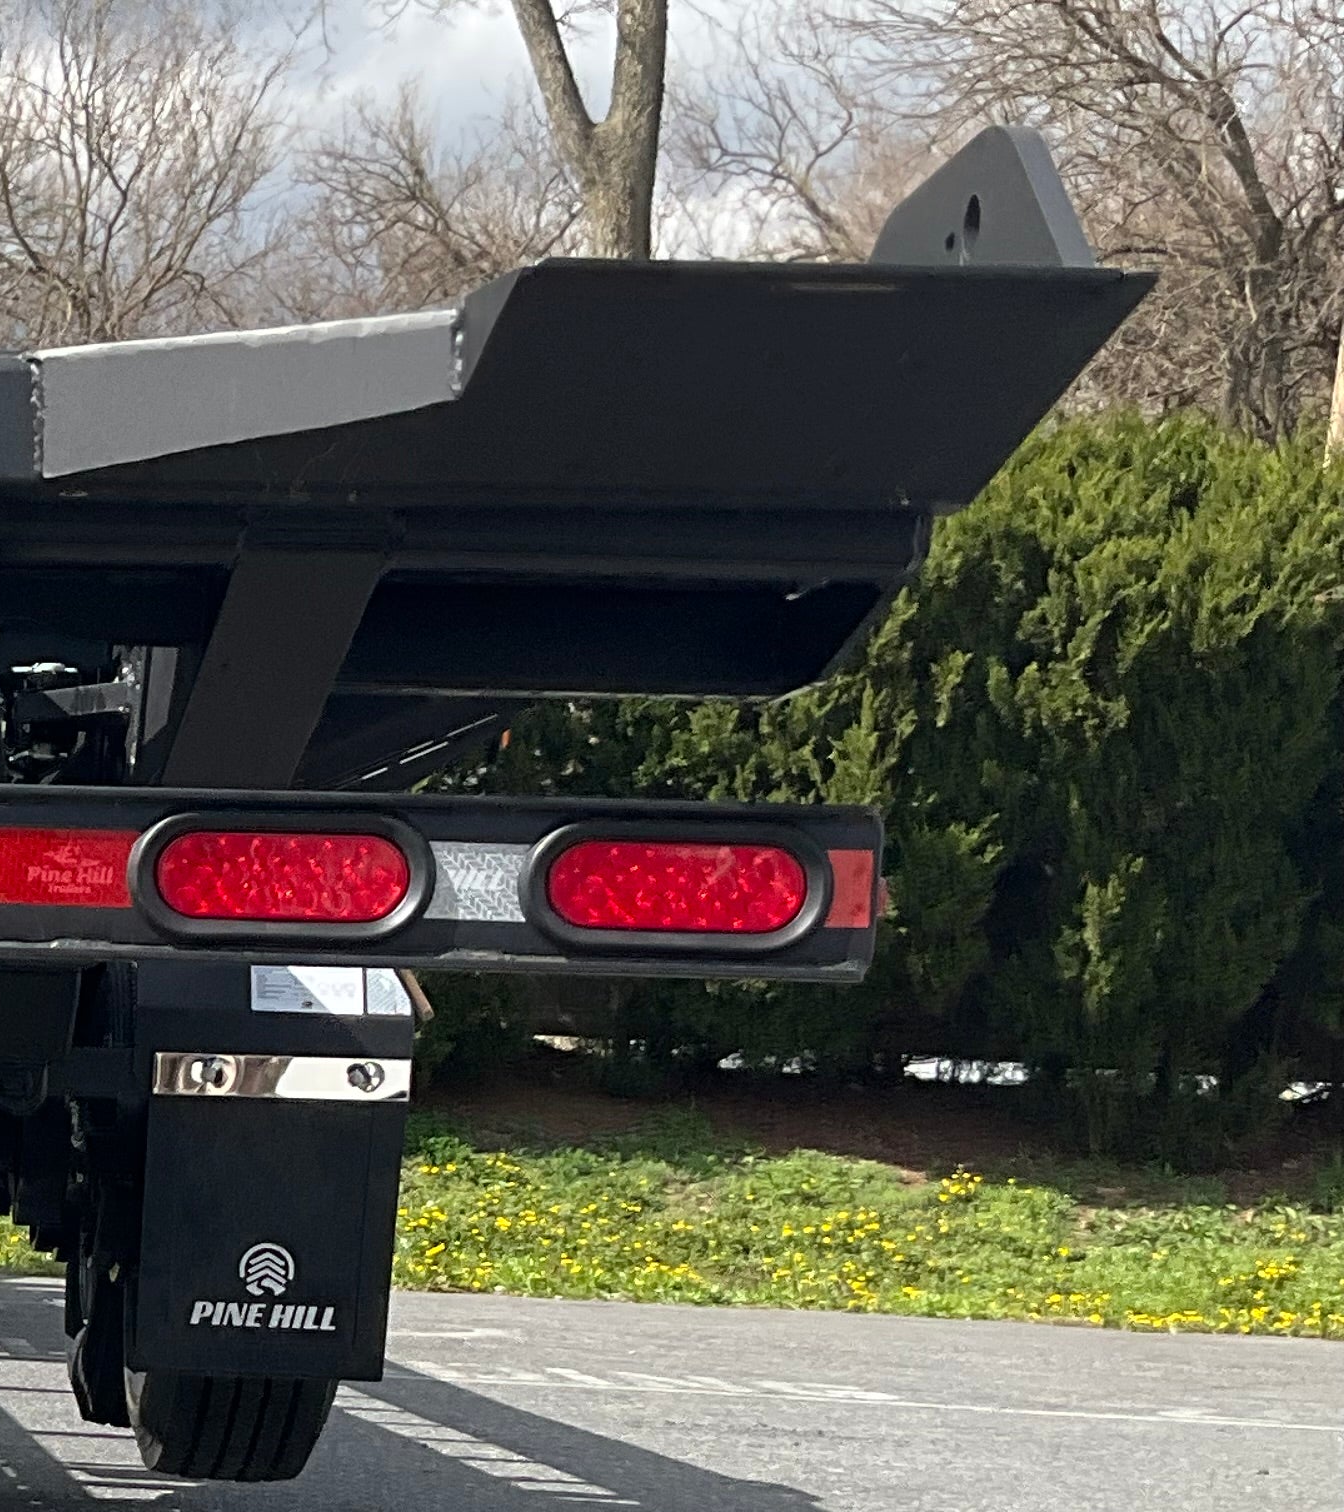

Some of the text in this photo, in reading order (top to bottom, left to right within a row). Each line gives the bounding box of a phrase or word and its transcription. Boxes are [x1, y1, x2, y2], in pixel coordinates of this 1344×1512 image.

[27, 865, 113, 884] Pine Hill
[189, 1300, 337, 1331] PINE HILL
